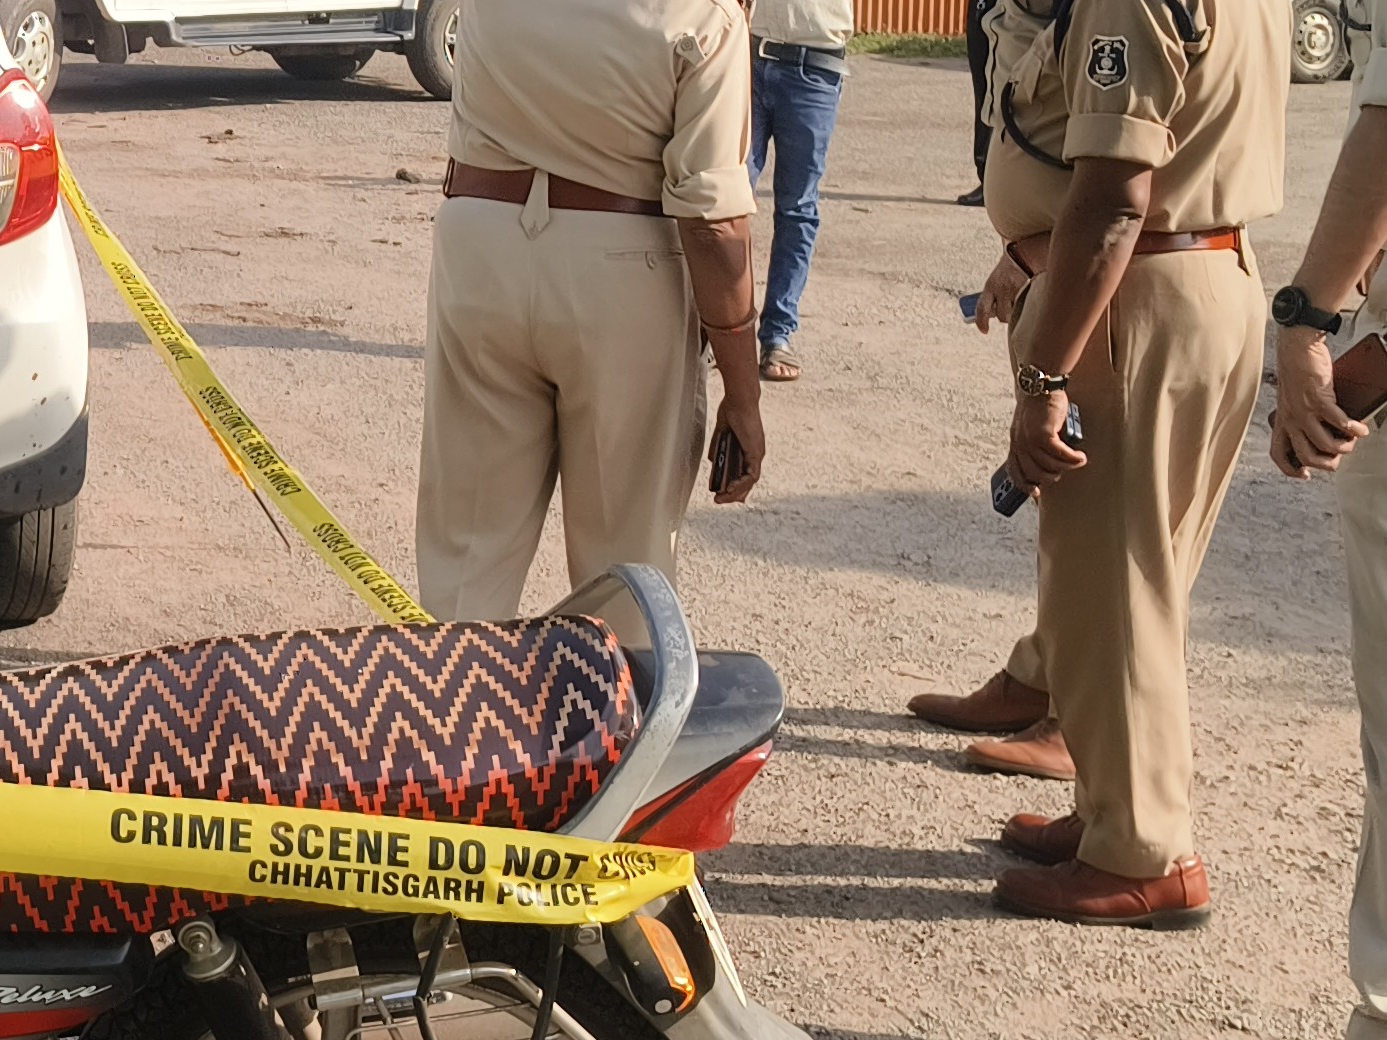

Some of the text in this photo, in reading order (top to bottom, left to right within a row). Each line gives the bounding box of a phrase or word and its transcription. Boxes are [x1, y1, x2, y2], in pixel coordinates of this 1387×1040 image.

[110, 807, 252, 853] CRIME
[269, 821, 411, 868] SCENE
[428, 835, 486, 875] DO
[502, 844, 590, 881] NOT
[248, 859, 599, 906] CHHATTISGARH POLICE
